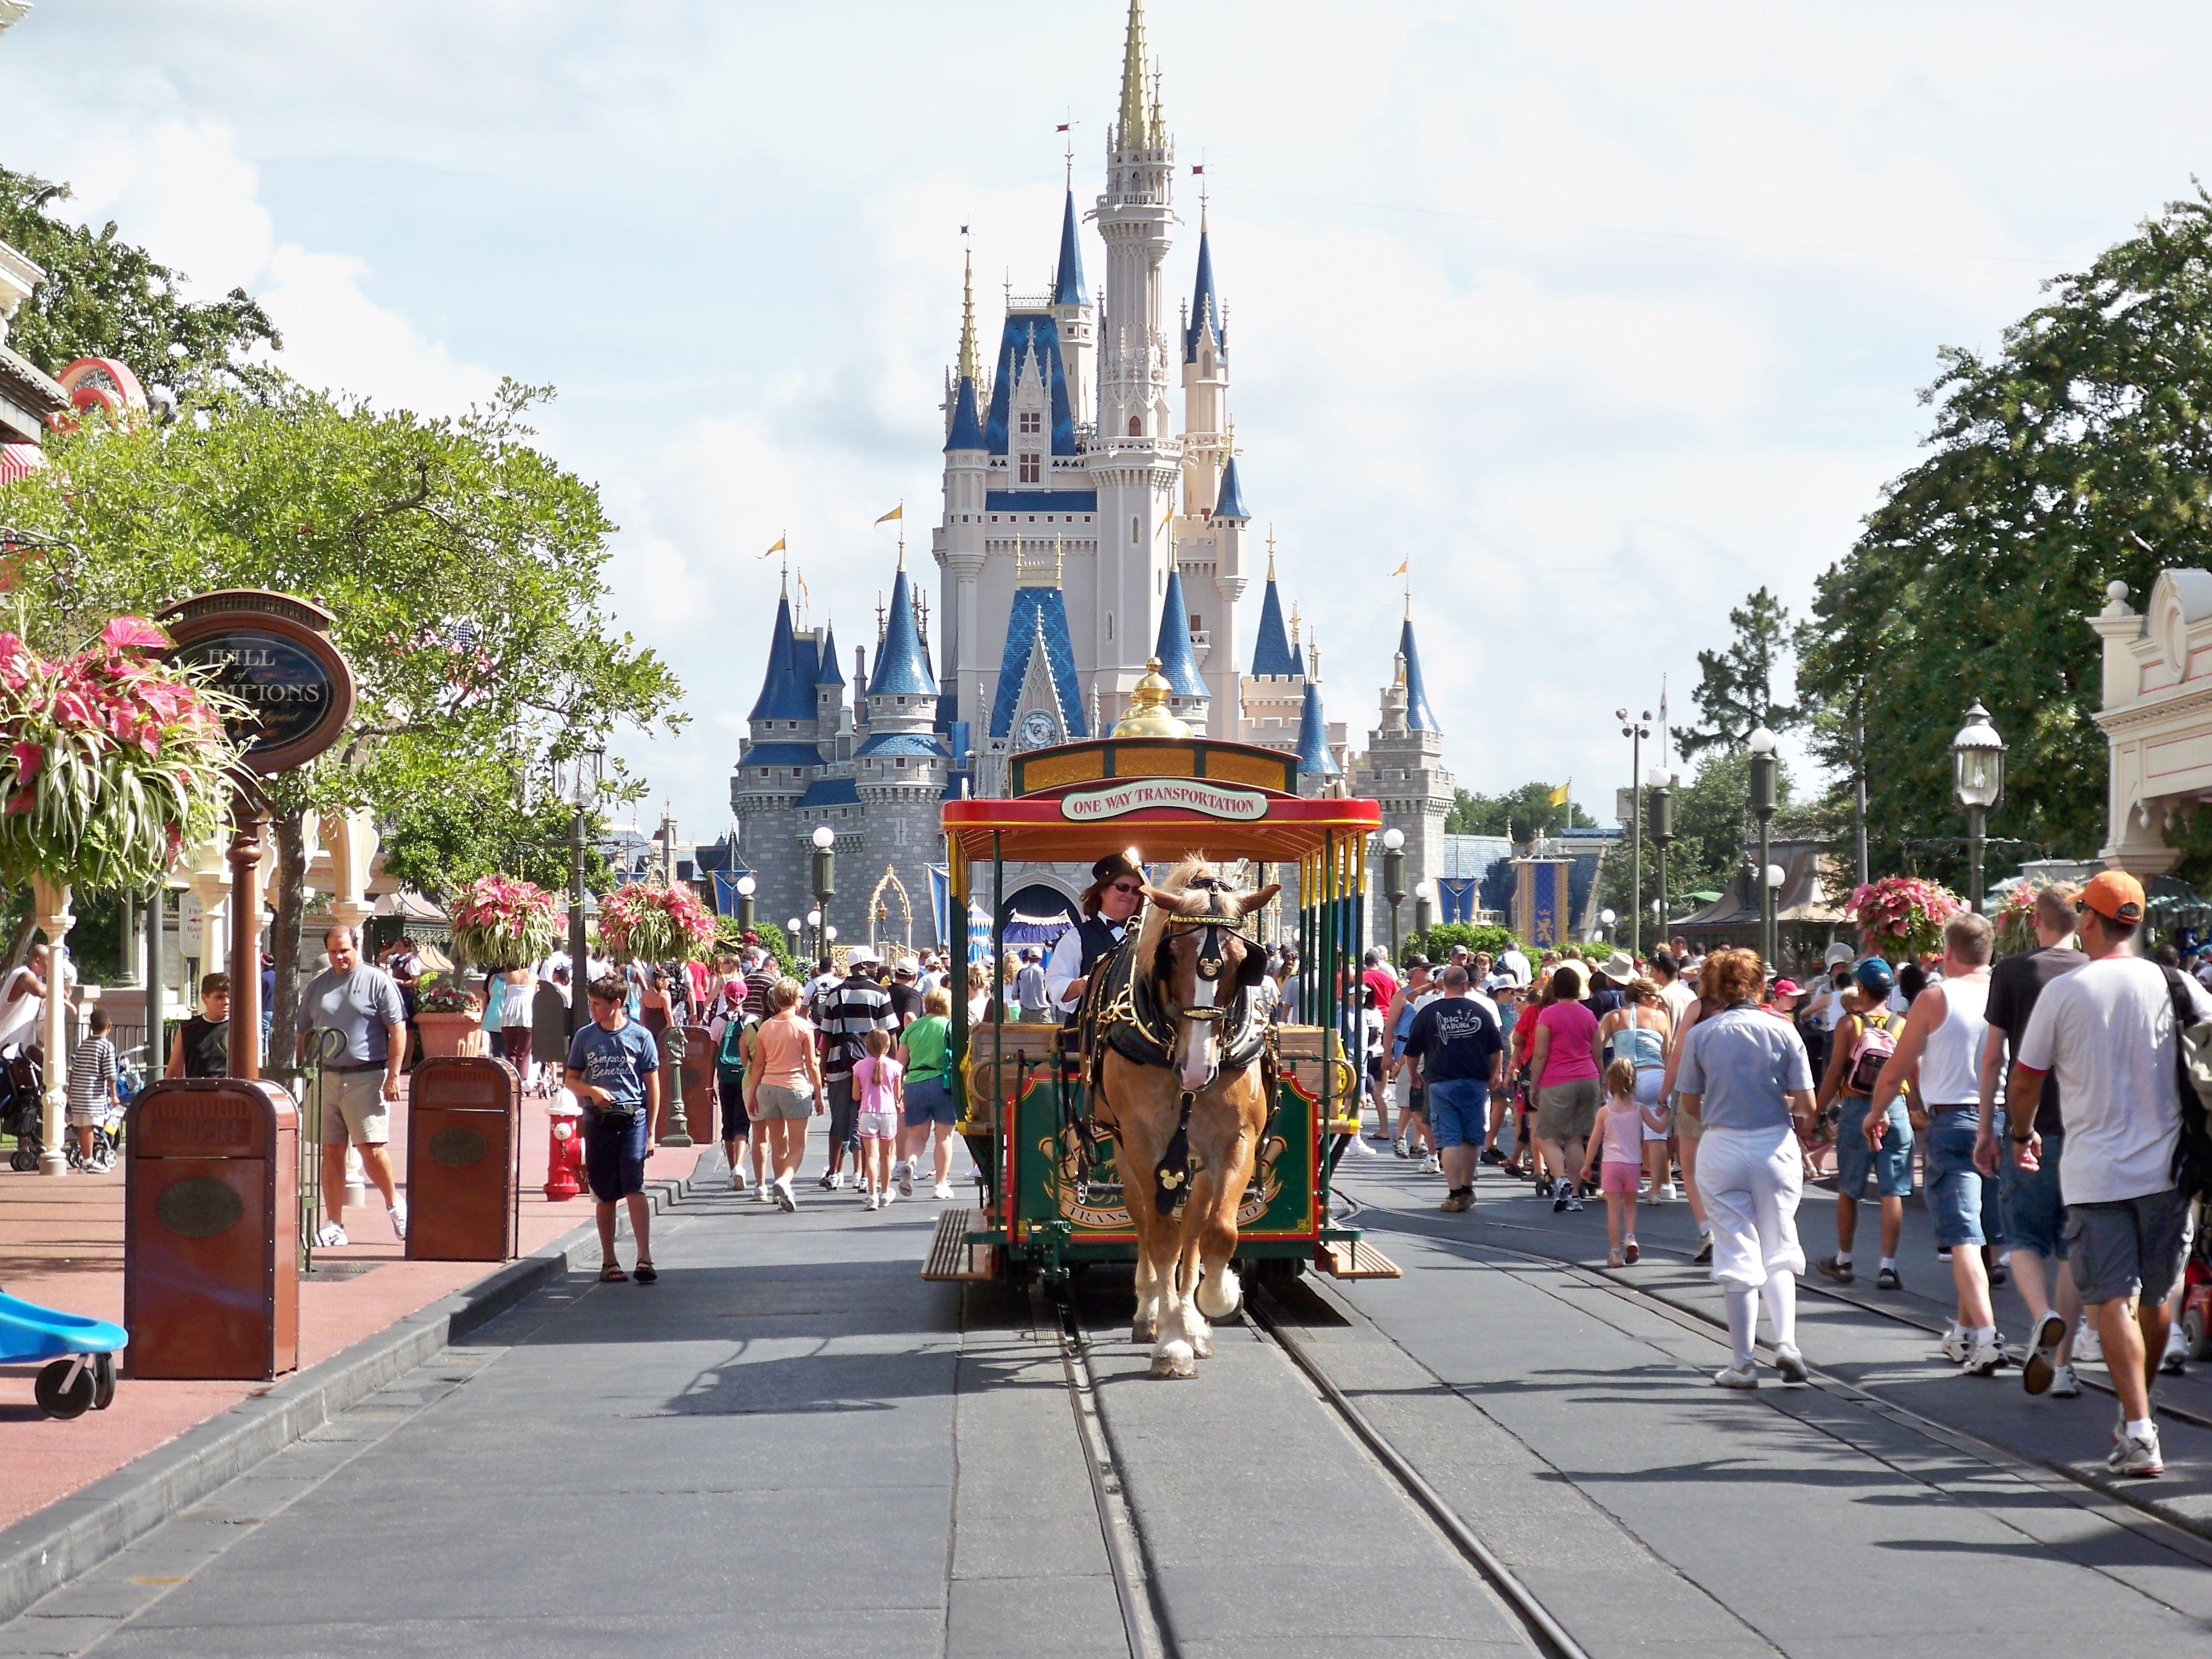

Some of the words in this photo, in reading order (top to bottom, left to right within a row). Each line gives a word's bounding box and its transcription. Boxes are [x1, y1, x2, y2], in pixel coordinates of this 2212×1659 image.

[207, 649, 275, 666] HALL
[233, 668, 252, 683] of
[203, 683, 320, 702] MPIONS
[1073, 799, 1101, 814] ONE
[1105, 791, 1133, 809] WAY
[1134, 787, 1254, 813] TRANSPORTATION
